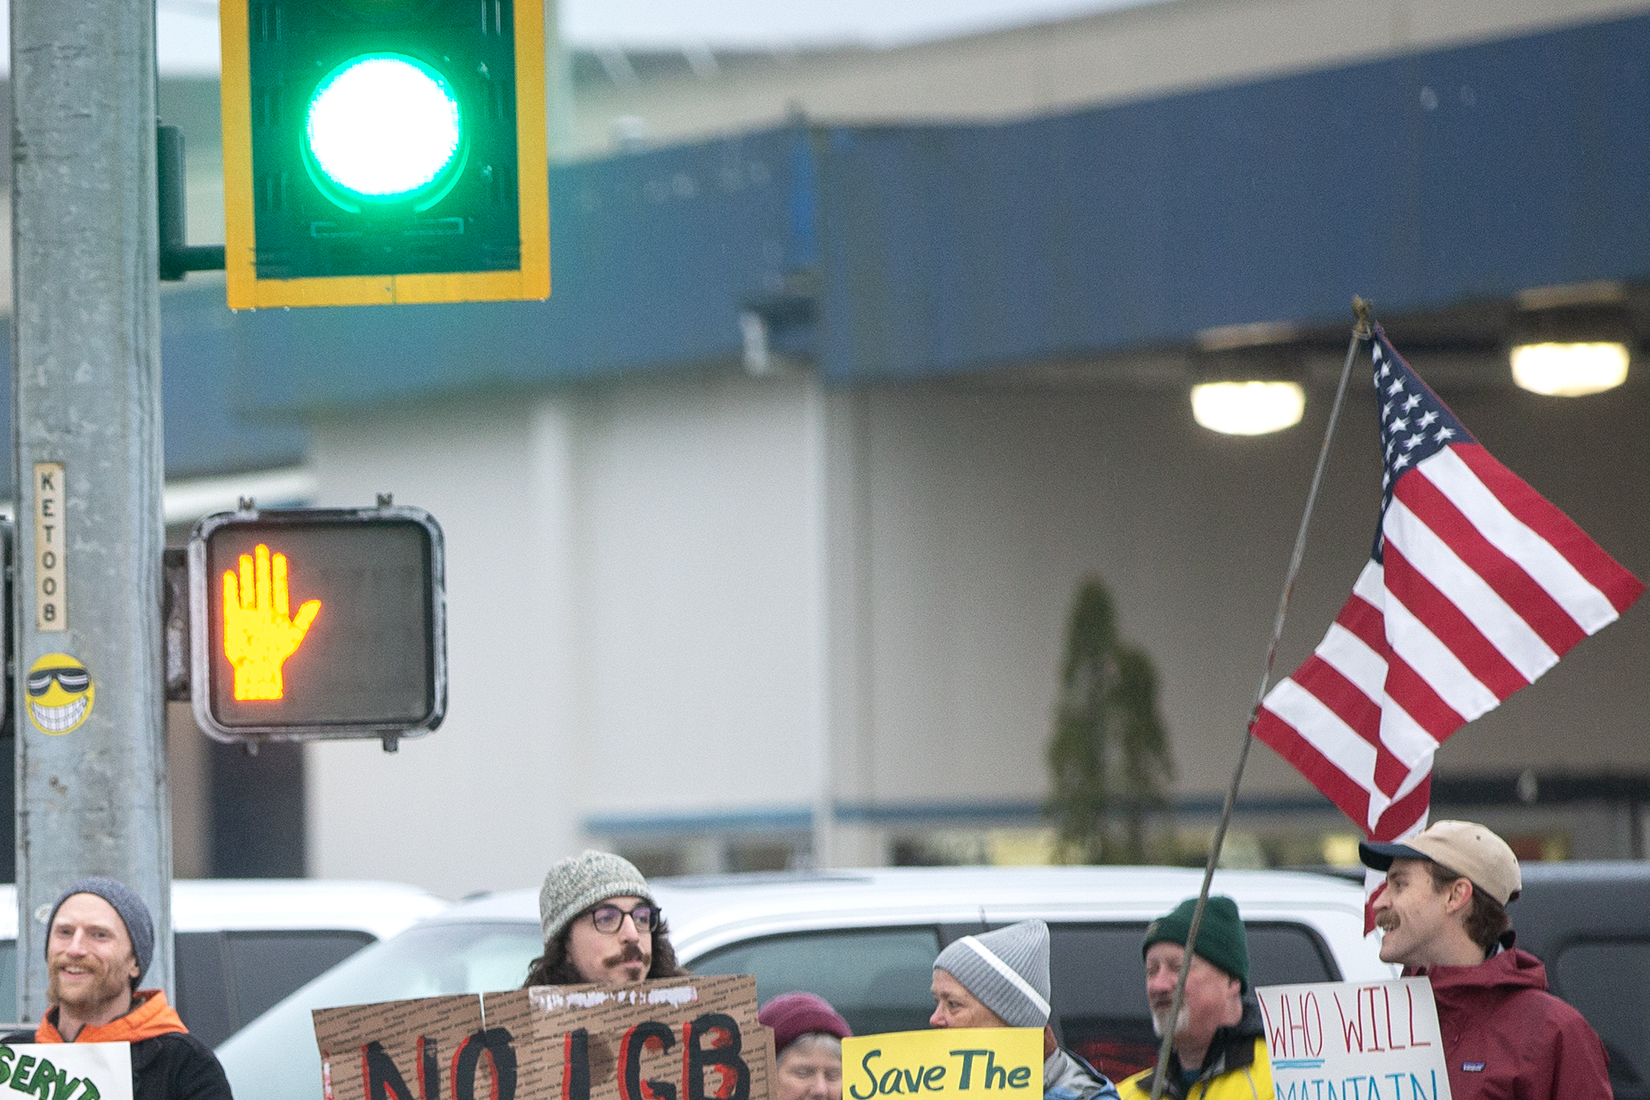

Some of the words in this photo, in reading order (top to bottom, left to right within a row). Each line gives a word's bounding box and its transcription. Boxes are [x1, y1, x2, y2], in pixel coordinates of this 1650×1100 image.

[1257, 990, 1323, 1058] WHO
[1334, 983, 1431, 1054] WILL
[850, 1049, 946, 1100] Save
[949, 1049, 1031, 1090] The
